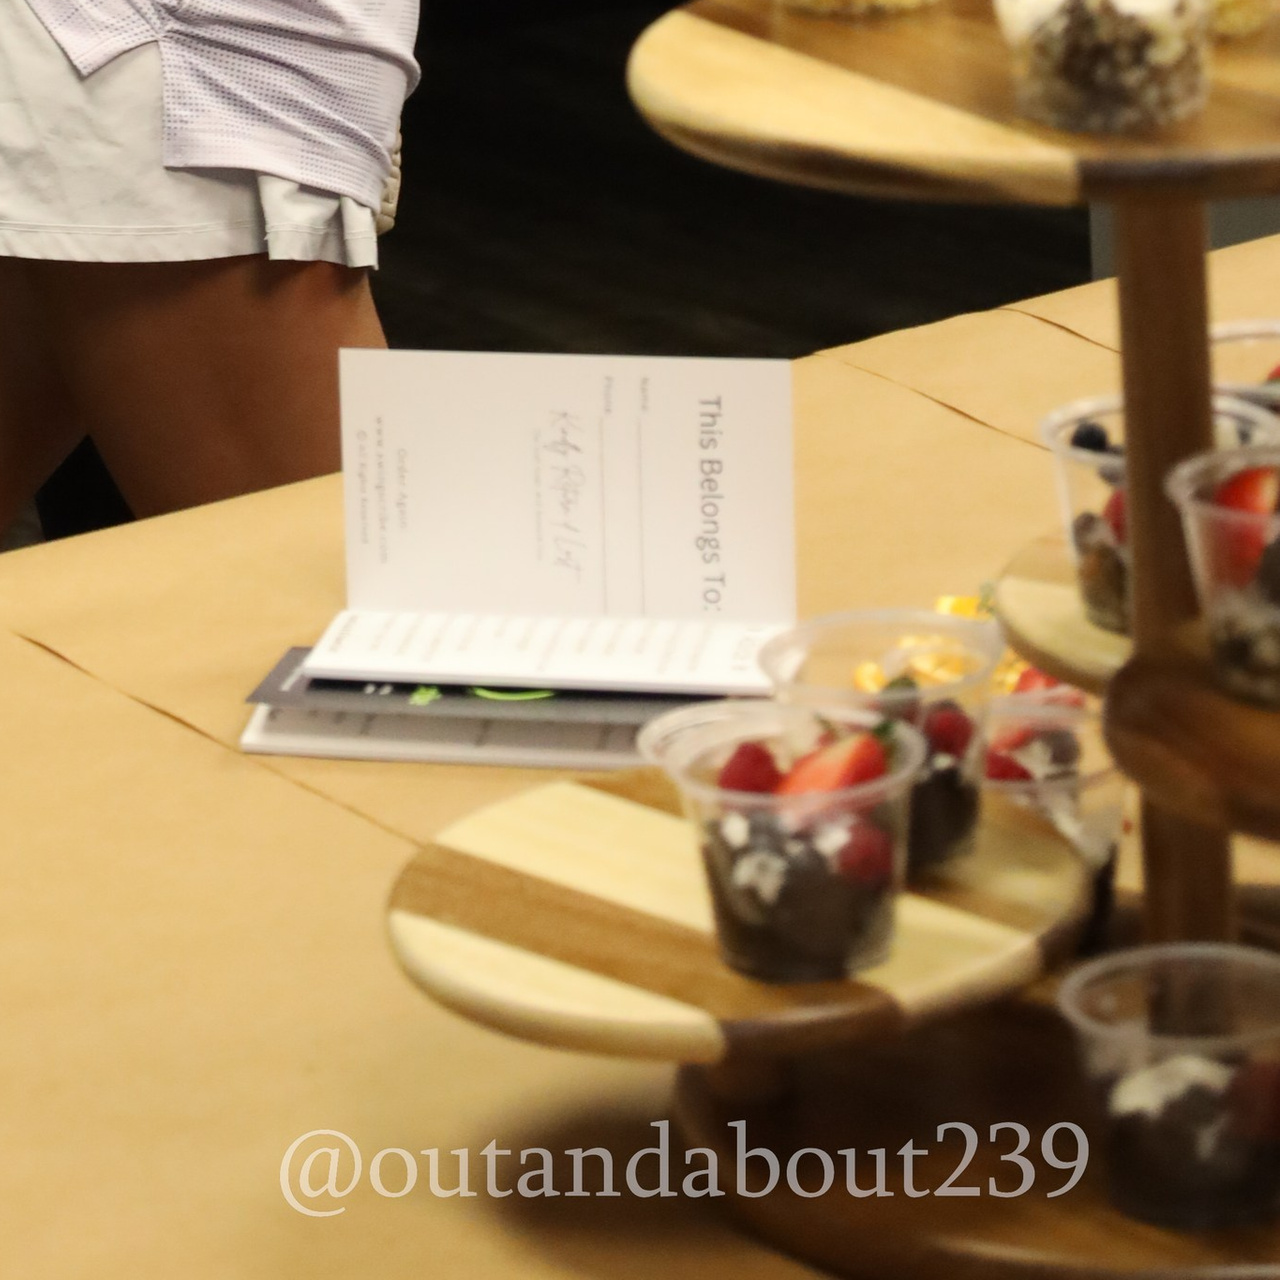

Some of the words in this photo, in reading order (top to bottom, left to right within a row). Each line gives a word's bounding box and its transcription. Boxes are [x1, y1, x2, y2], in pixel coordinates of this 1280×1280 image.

[699, 395, 723, 450] This
[696, 458, 725, 566] Belongs
[703, 573, 727, 613] To:
